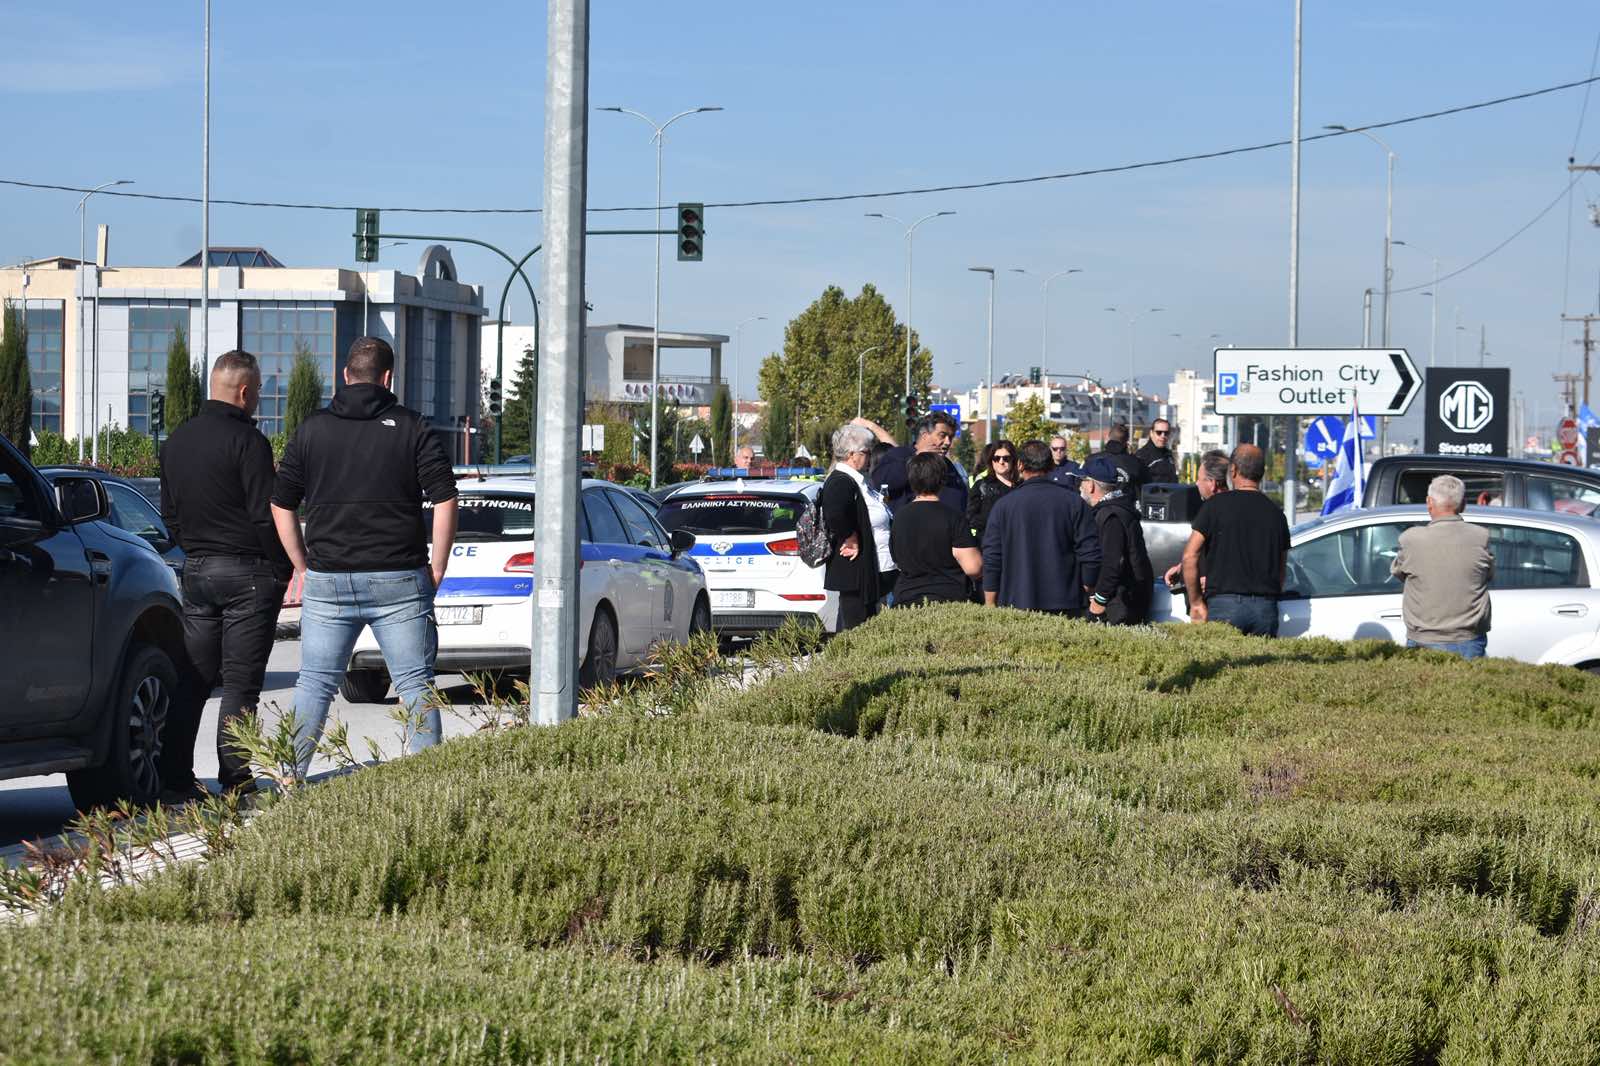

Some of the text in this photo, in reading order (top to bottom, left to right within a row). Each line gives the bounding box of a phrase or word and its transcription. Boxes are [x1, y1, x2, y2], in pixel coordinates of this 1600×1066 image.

[1247, 365, 1380, 385] Fashion City
[1221, 375, 1236, 393] P
[1279, 387, 1346, 404] Outlet
[1443, 384, 1490, 430] MG
[1438, 442, 1493, 454] Since 1924
[681, 500, 780, 510] ΕΛΛΗΝΙΚΗ ΑΣΤΥΝΟΜΙΑ
[703, 556, 755, 565] OLICE
